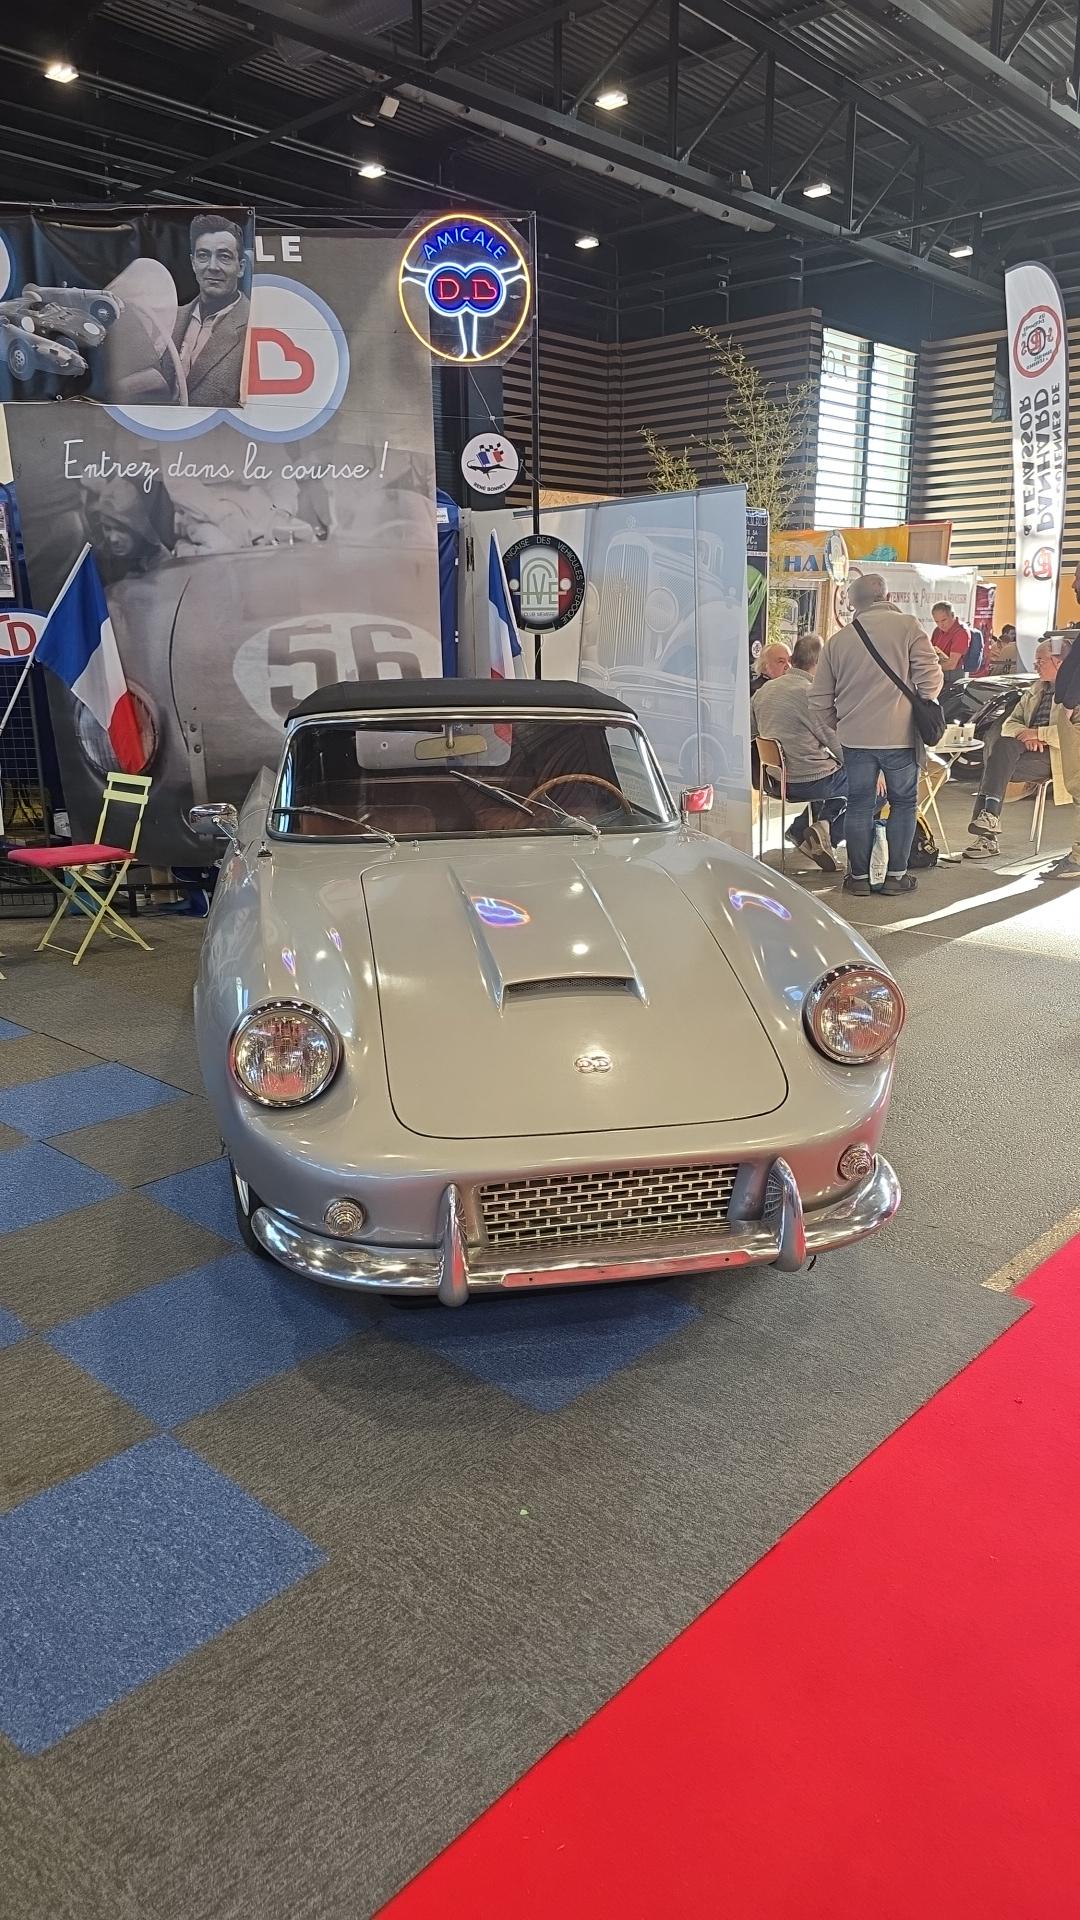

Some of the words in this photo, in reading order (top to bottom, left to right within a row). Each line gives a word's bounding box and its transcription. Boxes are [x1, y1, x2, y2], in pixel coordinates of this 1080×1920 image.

[422, 226, 507, 260] AMICALE
[64, 439, 160, 493] Entrez
[168, 451, 234, 479] dans
[243, 441, 273, 480] la
[281, 456, 371, 480] course
[380, 440, 390, 479] !
[536, 536, 551, 545] DES
[267, 623, 422, 719] 56
